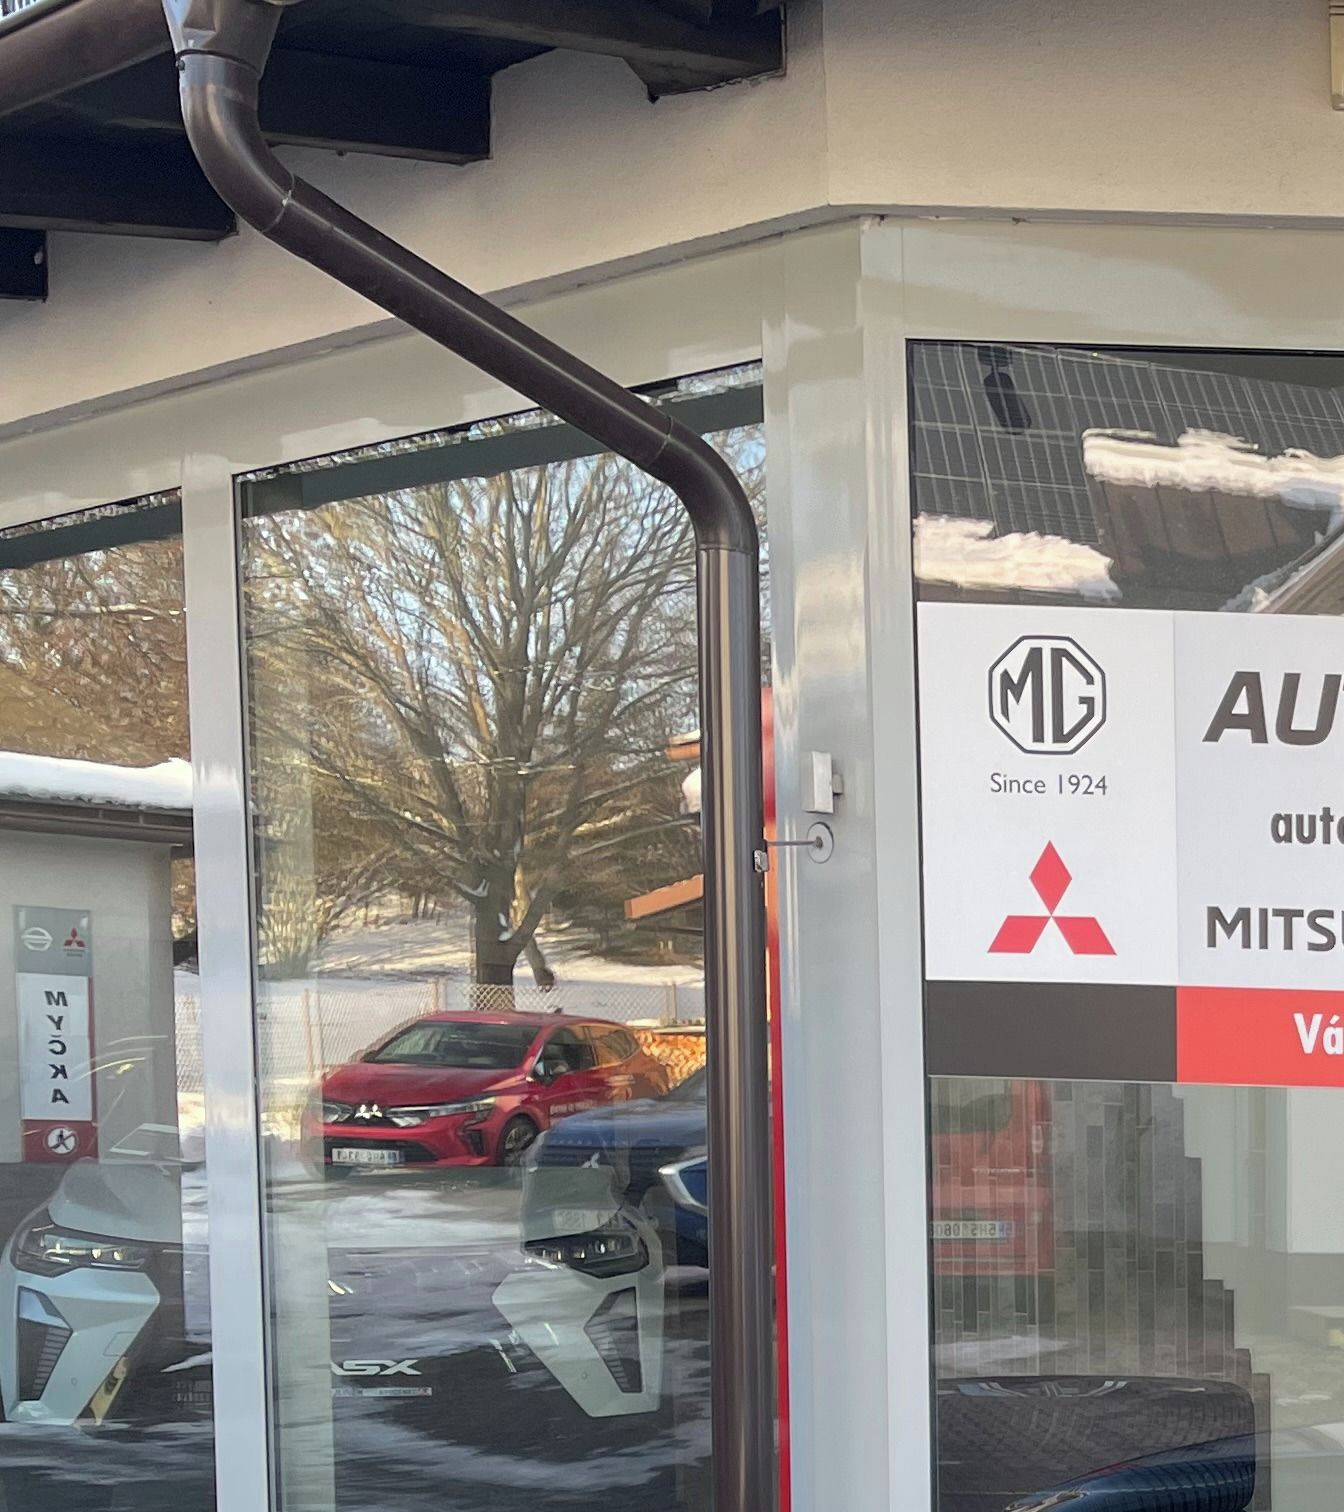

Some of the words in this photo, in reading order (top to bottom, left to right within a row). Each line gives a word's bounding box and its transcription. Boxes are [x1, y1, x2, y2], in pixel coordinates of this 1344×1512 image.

[989, 636, 1106, 755] MG
[990, 772, 1046, 795] Since
[1057, 773, 1108, 797] 1924
